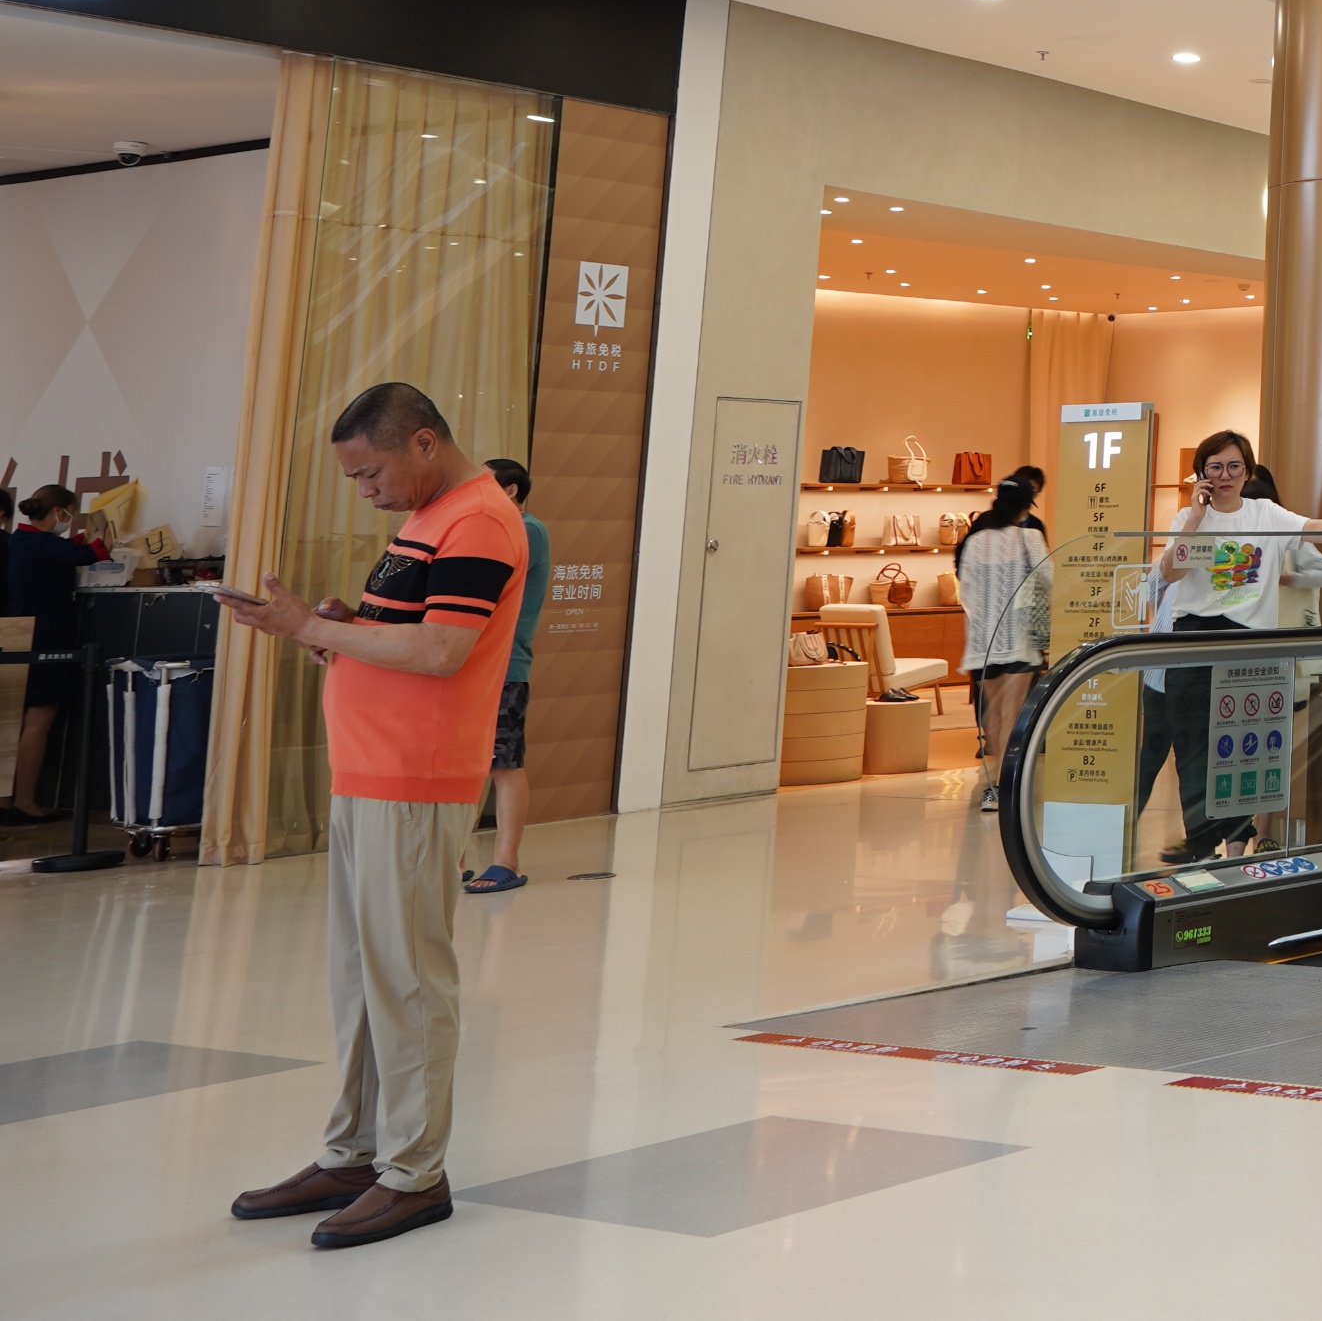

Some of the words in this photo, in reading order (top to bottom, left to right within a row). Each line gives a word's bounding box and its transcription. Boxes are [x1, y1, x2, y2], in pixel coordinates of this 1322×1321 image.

[572, 341, 622, 357] 海旅免税
[571, 359, 620, 372] HTDF
[731, 444, 778, 465] 消火栓
[1083, 431, 1122, 469] 1F
[722, 475, 744, 485] FIRE
[747, 475, 783, 485] HYDRANT
[1094, 483, 1106, 492] 6F
[1093, 512, 1104, 522] 5F
[1092, 542, 1104, 551] 4F
[552, 564, 604, 581] 海旅免税
[551, 584, 602, 601] 营业时间
[1090, 586, 1102, 596] 3F
[565, 608, 584, 616] OPEN
[1088, 618, 1100, 627] 2F
[1087, 679, 1098, 689] 1F
[1085, 709, 1097, 719] B1
[1083, 755, 1095, 765] B2
[1148, 881, 1173, 895] 25
[1183, 925, 1212, 941] 961333
